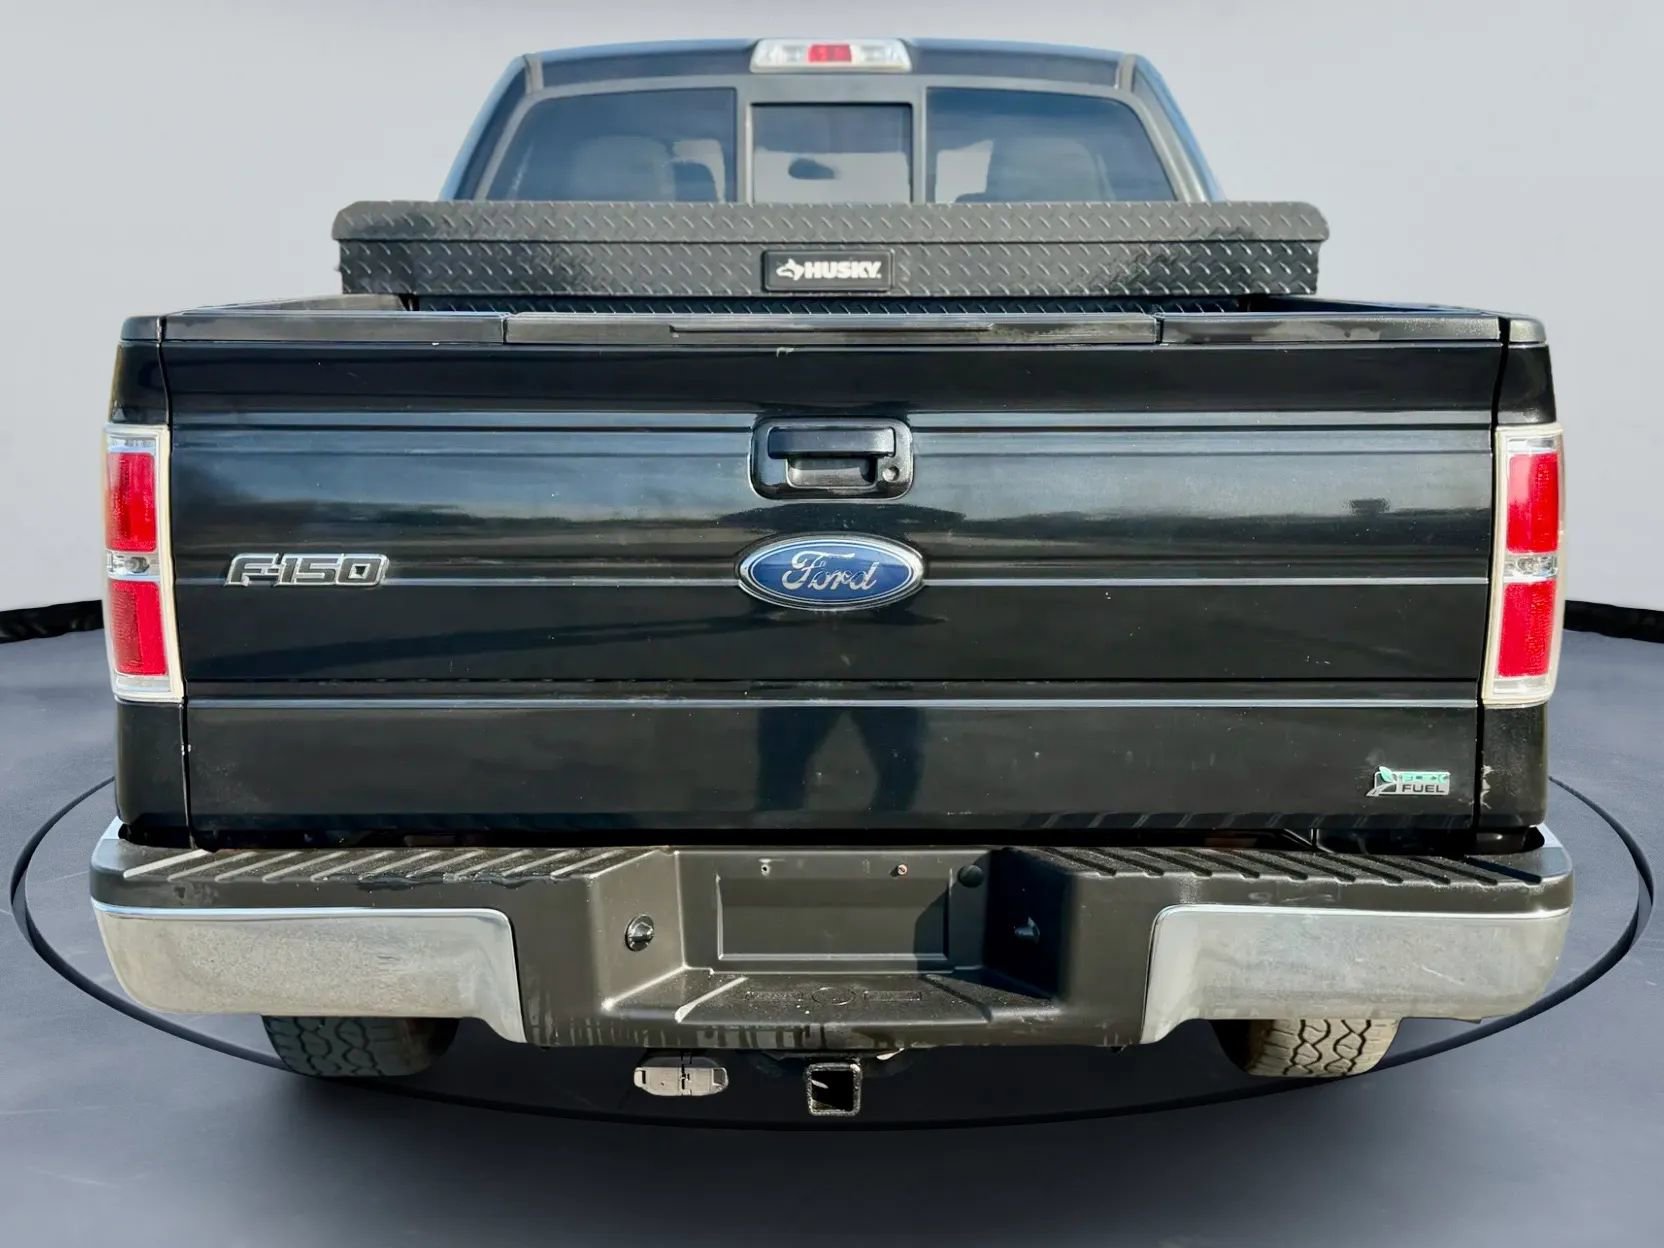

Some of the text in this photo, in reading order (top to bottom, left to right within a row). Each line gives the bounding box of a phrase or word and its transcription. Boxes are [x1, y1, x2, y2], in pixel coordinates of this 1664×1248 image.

[223, 552, 390, 587] F-150
[781, 550, 880, 591] Ford
[1401, 784, 1445, 793] FUEL
